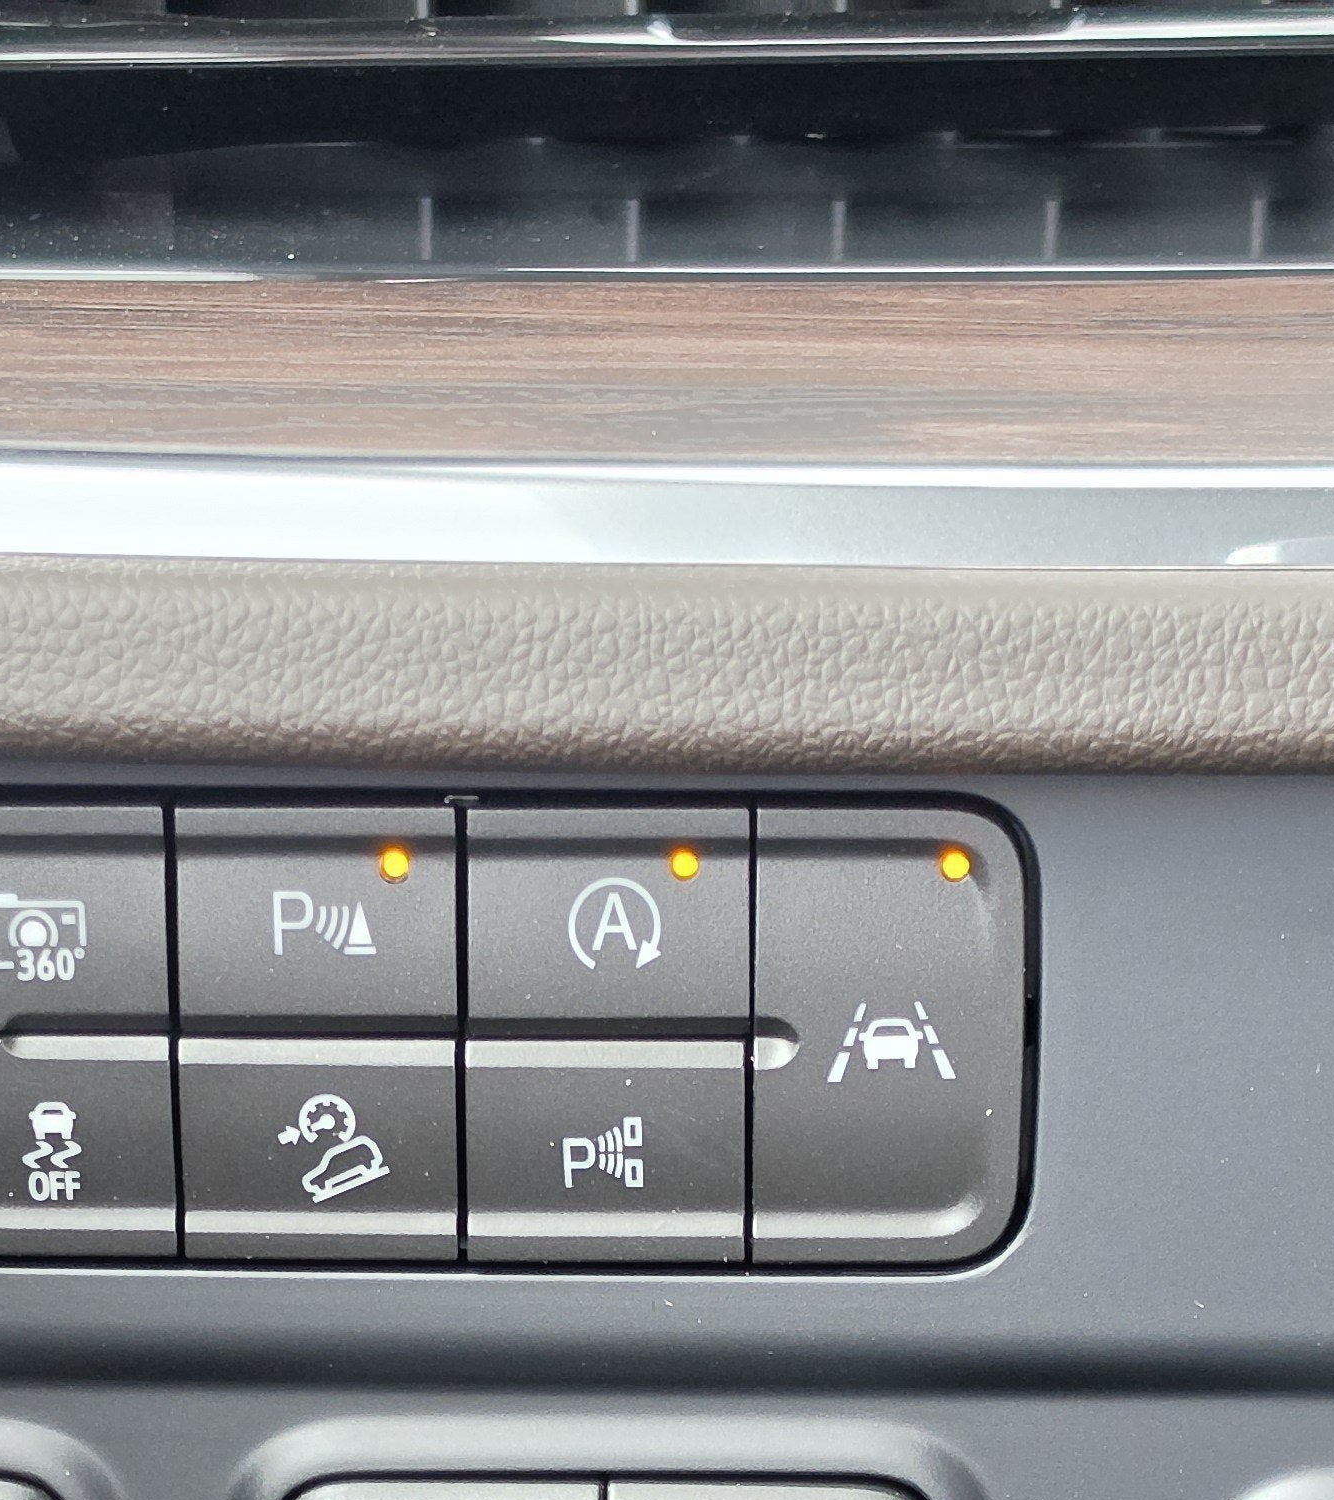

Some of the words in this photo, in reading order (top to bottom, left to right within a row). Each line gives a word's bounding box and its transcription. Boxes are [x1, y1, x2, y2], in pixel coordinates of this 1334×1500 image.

[273, 890, 312, 956] P
[592, 892, 637, 951] A
[28, 1170, 81, 1202] OFF
[562, 1137, 596, 1188] P
